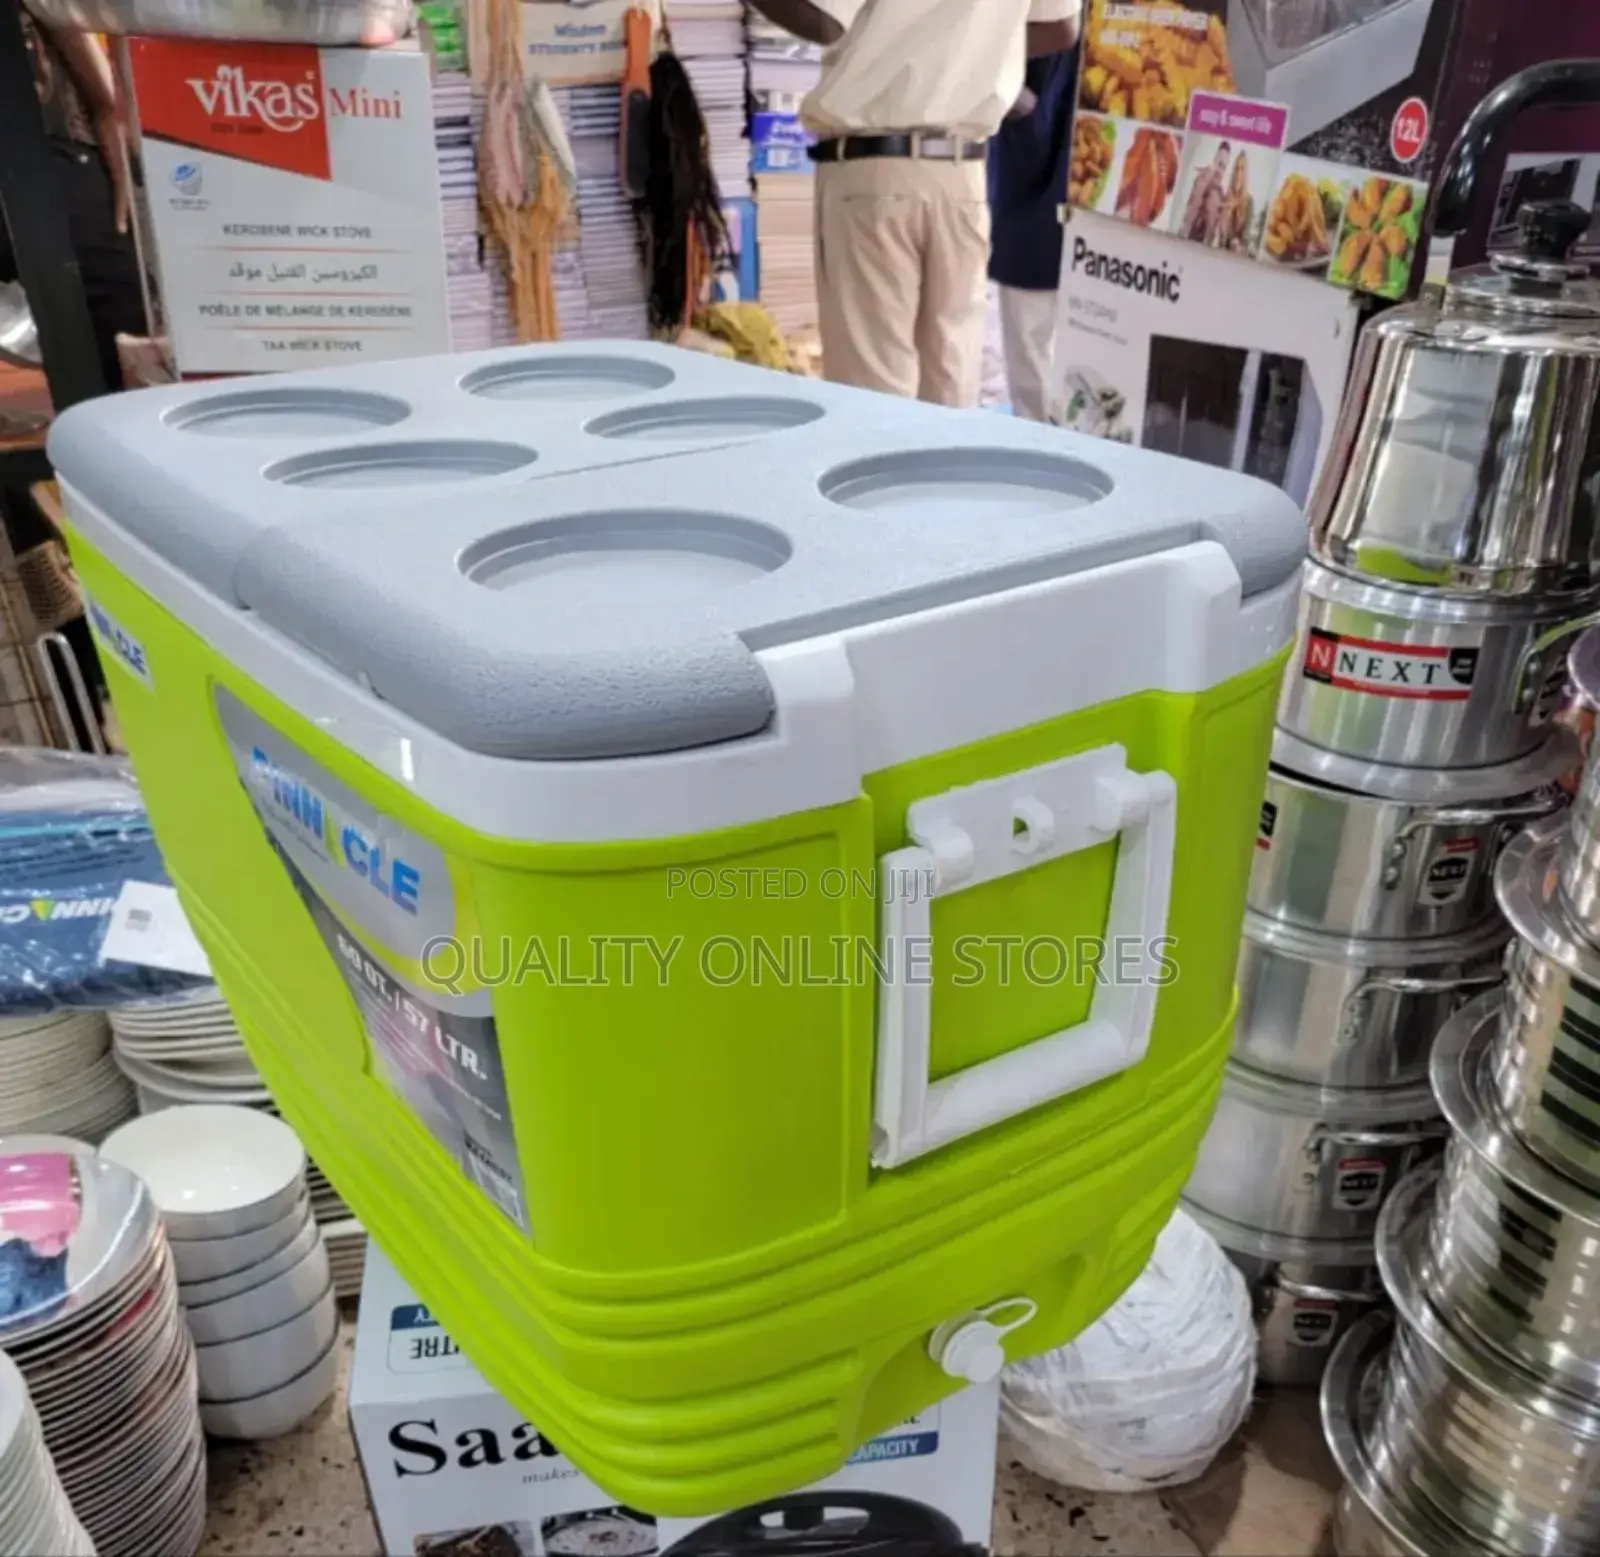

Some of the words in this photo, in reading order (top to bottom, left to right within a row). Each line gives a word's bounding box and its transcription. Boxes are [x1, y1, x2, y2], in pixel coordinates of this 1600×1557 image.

[329, 87, 403, 119] Mini
[1398, 116, 1420, 143] 12L
[297, 225, 328, 238] WICK
[332, 226, 372, 239] STOVE
[1071, 235, 1181, 304] Panasonic
[244, 304, 262, 317] DE
[328, 304, 343, 317] DE
[323, 341, 364, 352] STOVE
[1338, 650, 1442, 685] NEXT
